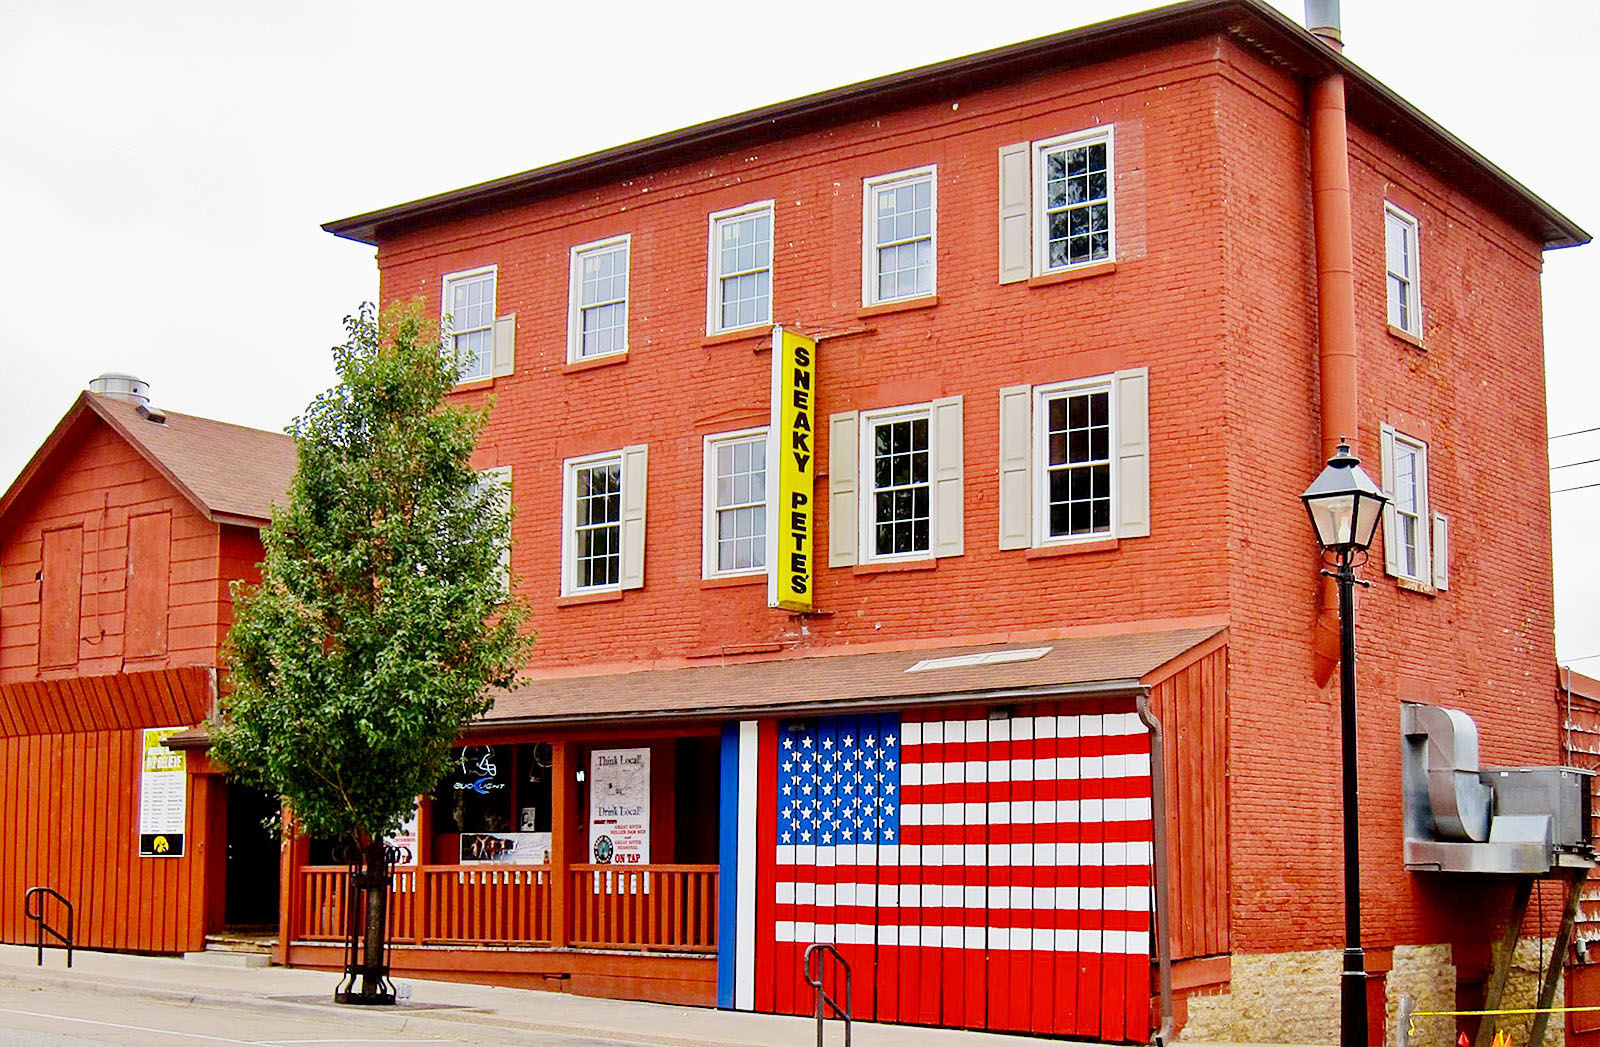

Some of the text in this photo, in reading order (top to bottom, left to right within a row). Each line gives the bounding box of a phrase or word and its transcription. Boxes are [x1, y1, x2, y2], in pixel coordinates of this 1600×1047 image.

[791, 346, 811, 595] SNEAKY PETE'S
[598, 756, 618, 766] Think
[478, 782, 506, 790] LIGHT
[598, 807, 618, 816] Drink
[615, 854, 641, 863] ON TAP
